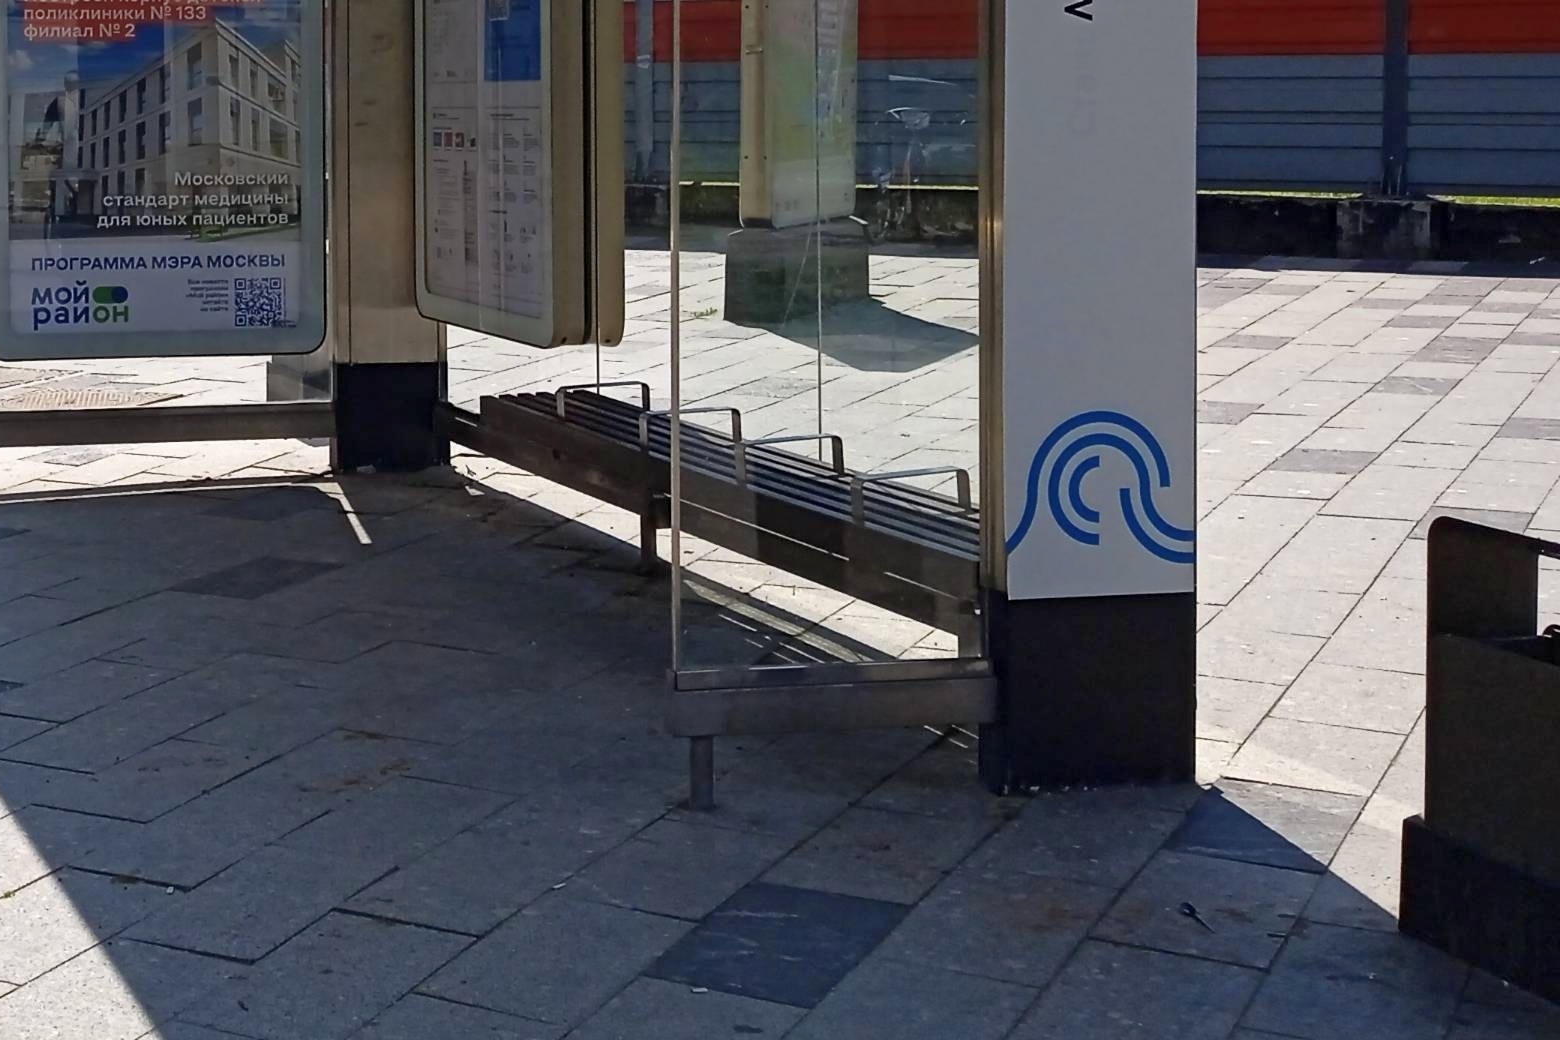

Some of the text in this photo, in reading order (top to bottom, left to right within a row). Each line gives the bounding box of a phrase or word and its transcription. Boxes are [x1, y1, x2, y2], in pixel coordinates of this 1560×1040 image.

[23, 5, 206, 20] поликлиники № 133
[23, 23, 136, 41] филиал № 2
[103, 192, 289, 209] стандарт медицины
[97, 212, 289, 229] для юных пациентов
[31, 254, 286, 271] ПРОГРАММА МЭРА МОСКВЫ
[31, 280, 90, 305] мой
[33, 306, 129, 330] район
